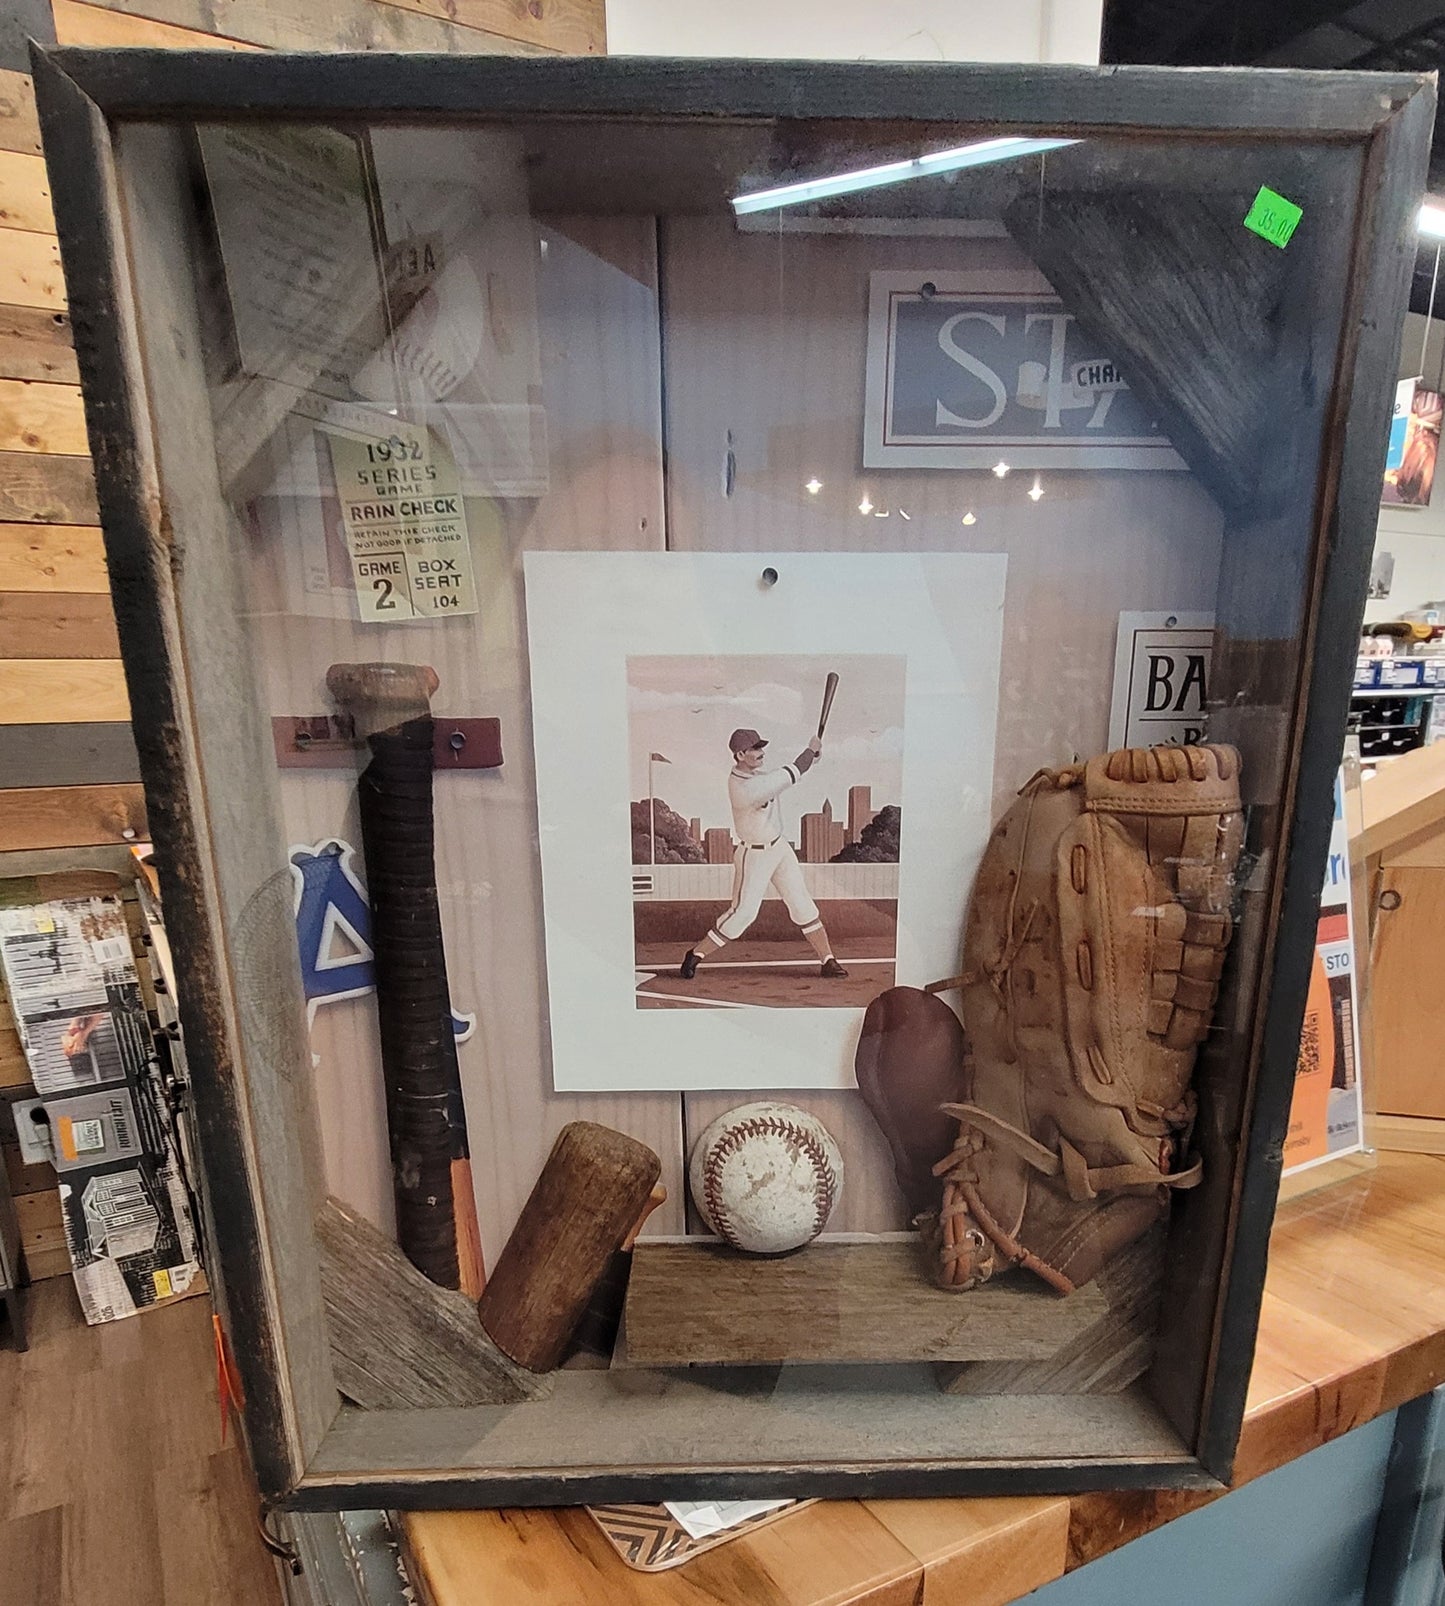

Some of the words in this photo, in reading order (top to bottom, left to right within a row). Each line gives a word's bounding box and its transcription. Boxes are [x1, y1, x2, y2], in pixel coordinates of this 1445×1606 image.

[357, 465, 437, 485] SERIES
[376, 484, 424, 496] GAME
[351, 502, 395, 521] RAIN
[400, 499, 458, 516] CHECK
[422, 524, 456, 534] CHECK
[355, 541, 374, 549] NOT
[414, 534, 462, 545] DETACHED
[358, 561, 401, 576] GAME
[418, 559, 456, 574] BOX
[414, 574, 462, 590] SEAT
[372, 579, 396, 610] 2
[433, 595, 460, 609] 104
[1144, 655, 1207, 711] BA
